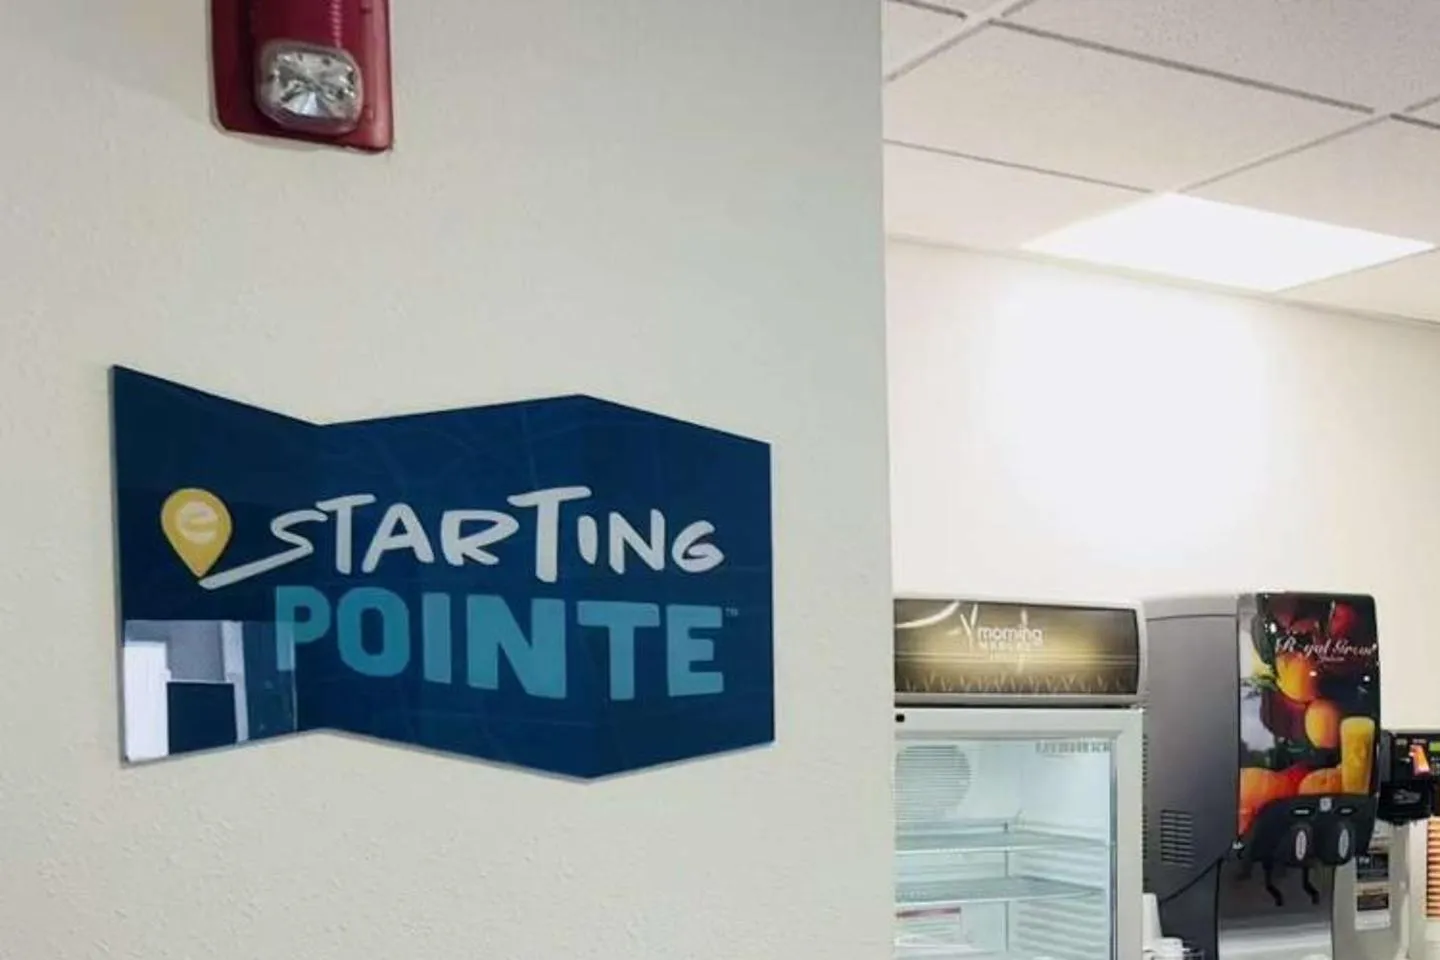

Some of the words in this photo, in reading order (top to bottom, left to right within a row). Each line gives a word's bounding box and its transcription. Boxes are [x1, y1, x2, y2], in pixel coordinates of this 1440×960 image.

[198, 486, 725, 590] STARTING
[275, 585, 724, 702] POINTE
[977, 623, 1043, 647] morning
